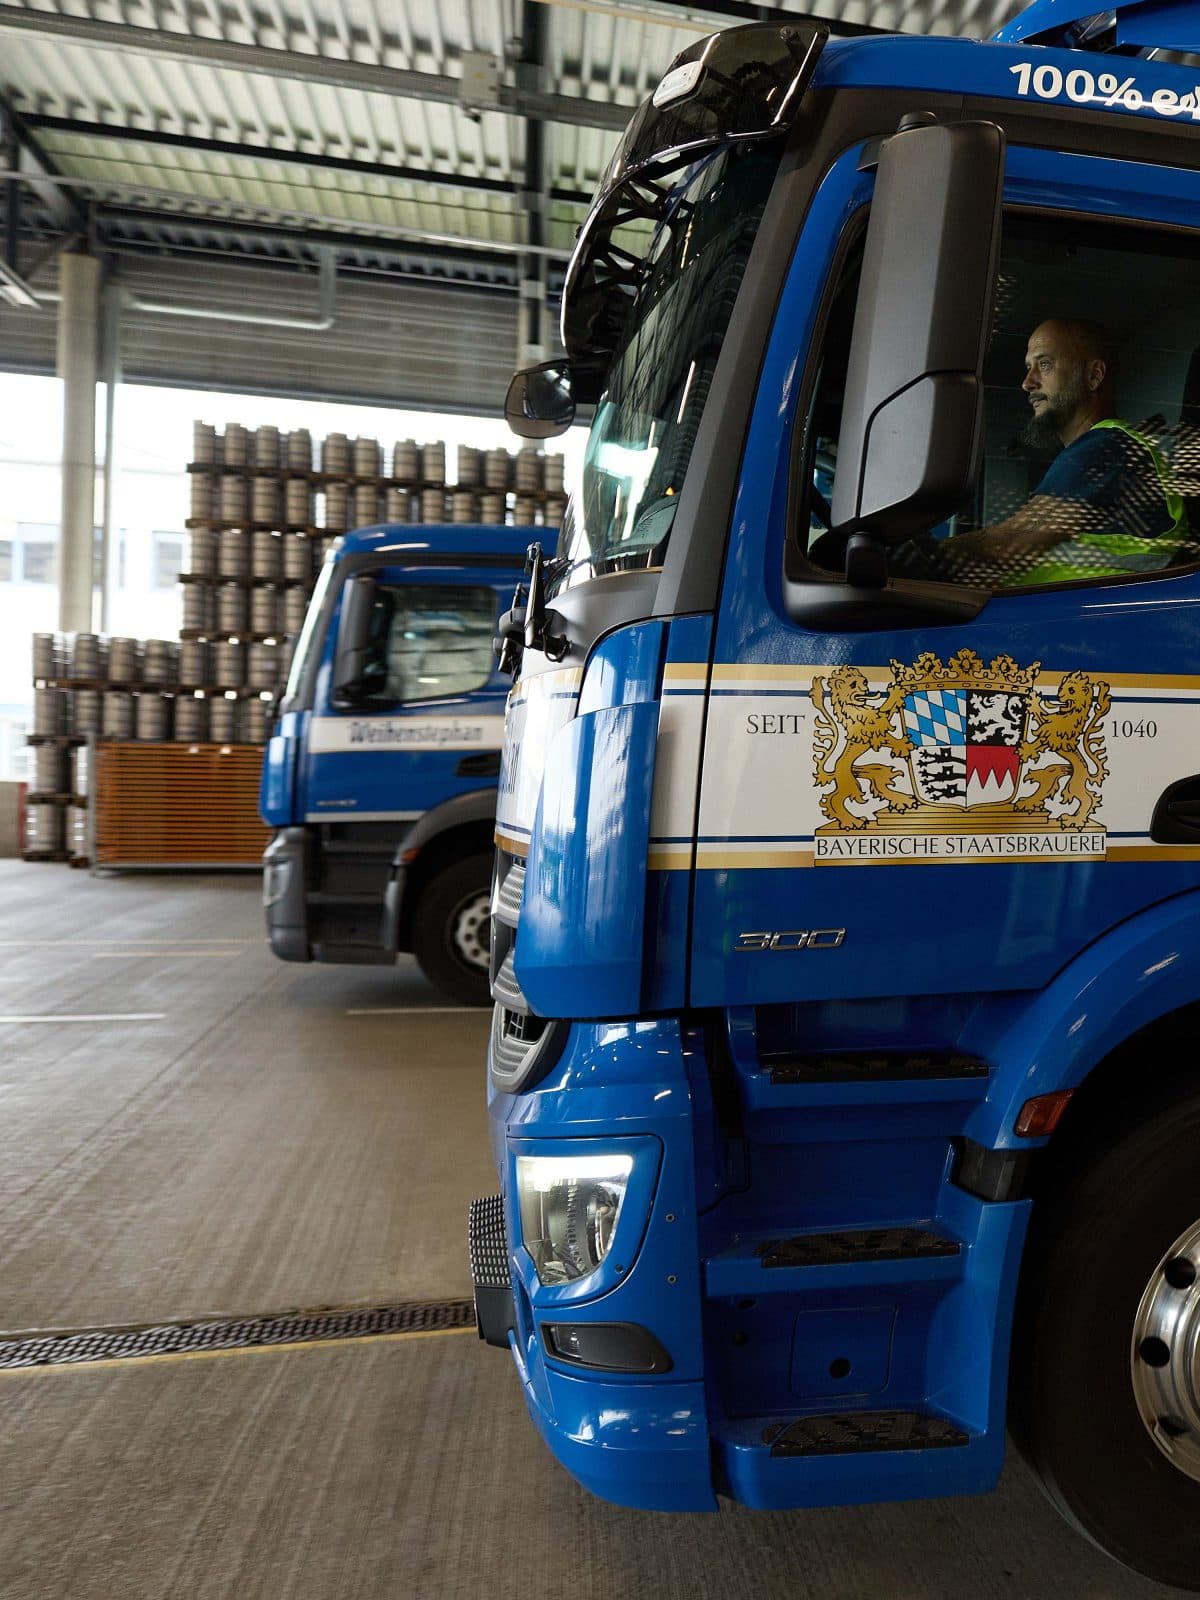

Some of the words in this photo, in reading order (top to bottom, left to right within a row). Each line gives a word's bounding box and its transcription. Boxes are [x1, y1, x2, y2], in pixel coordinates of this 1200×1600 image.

[1009, 62, 1142, 110] 100%
[746, 714, 806, 735] SEIT
[1111, 719, 1157, 738] 1040
[816, 837, 939, 856] BAYERISCHE
[945, 835, 1105, 854] STAATSBRAUEREI
[735, 928, 846, 951] 300
